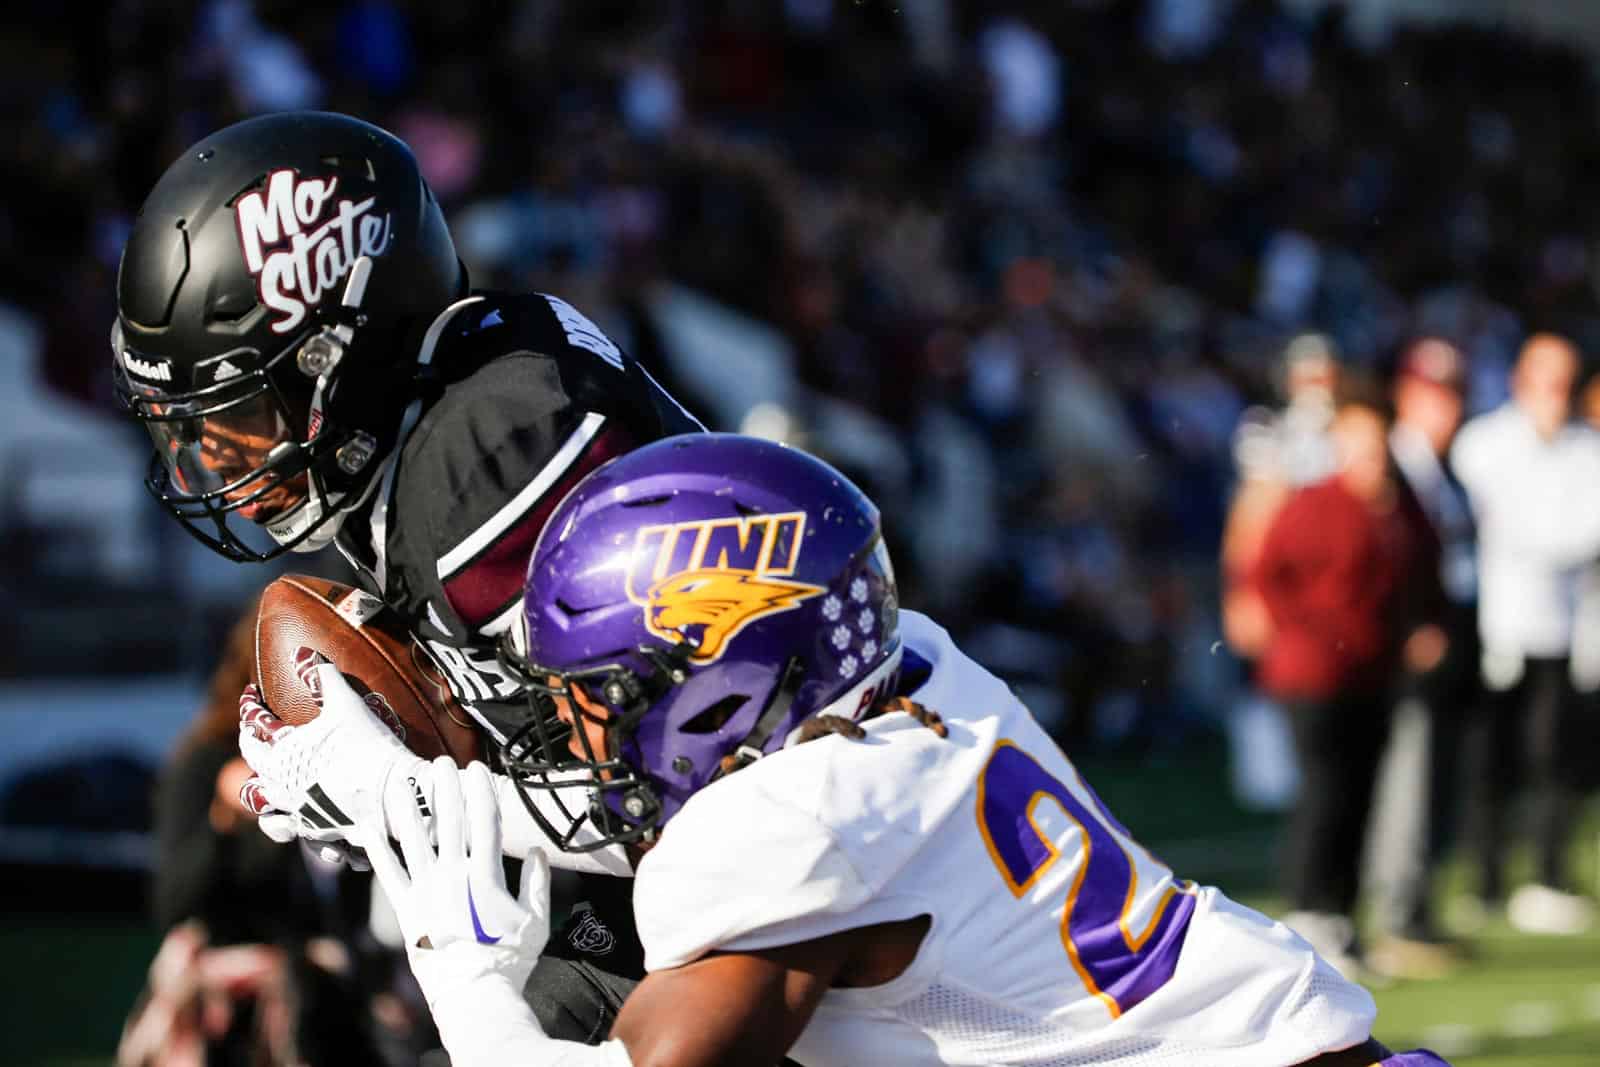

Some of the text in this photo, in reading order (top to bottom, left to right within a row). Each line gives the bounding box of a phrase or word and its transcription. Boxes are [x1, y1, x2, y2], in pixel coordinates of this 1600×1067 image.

[236, 168, 338, 275] Mo
[260, 197, 390, 334] State
[625, 511, 807, 606] UNI
